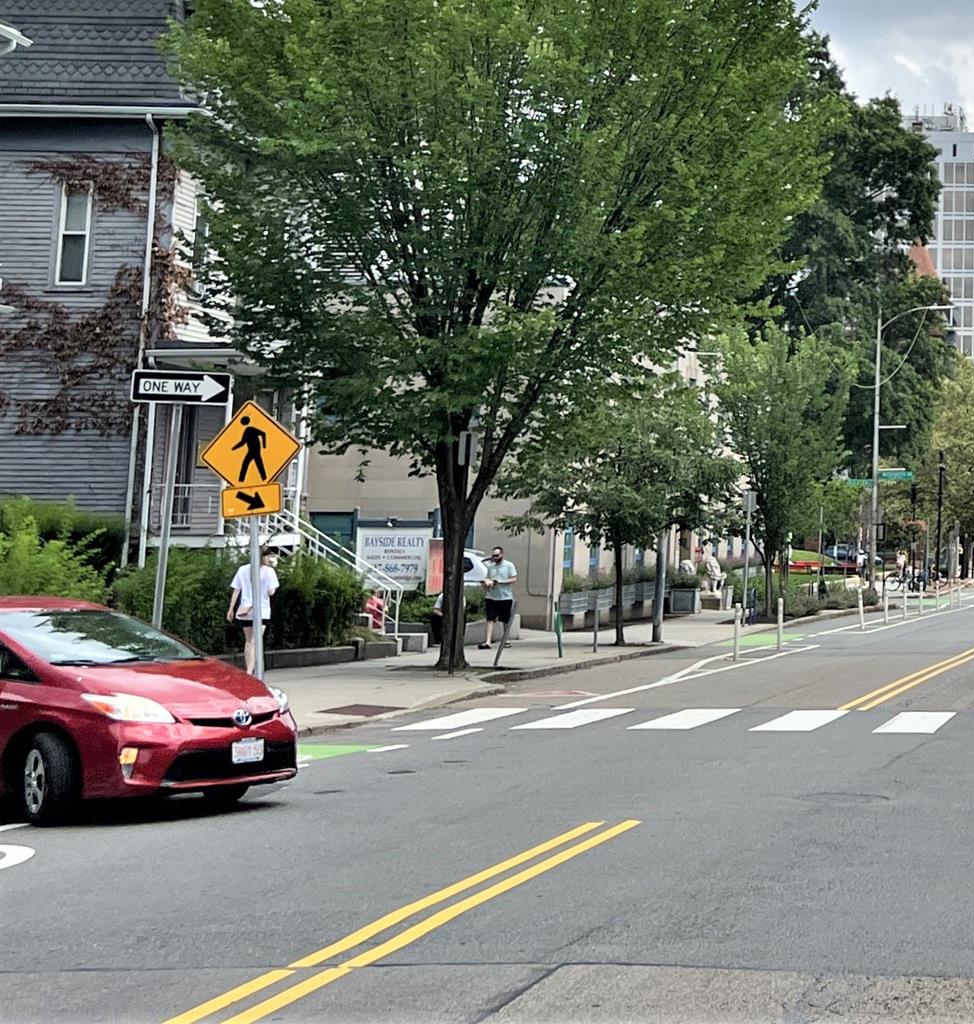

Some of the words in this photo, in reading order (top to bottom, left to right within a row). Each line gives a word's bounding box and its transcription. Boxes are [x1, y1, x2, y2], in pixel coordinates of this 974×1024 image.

[143, 380, 169, 393] ONE
[174, 381, 201, 394] WAY
[364, 536, 396, 548] BAYSIDE
[397, 536, 424, 548] REALTY
